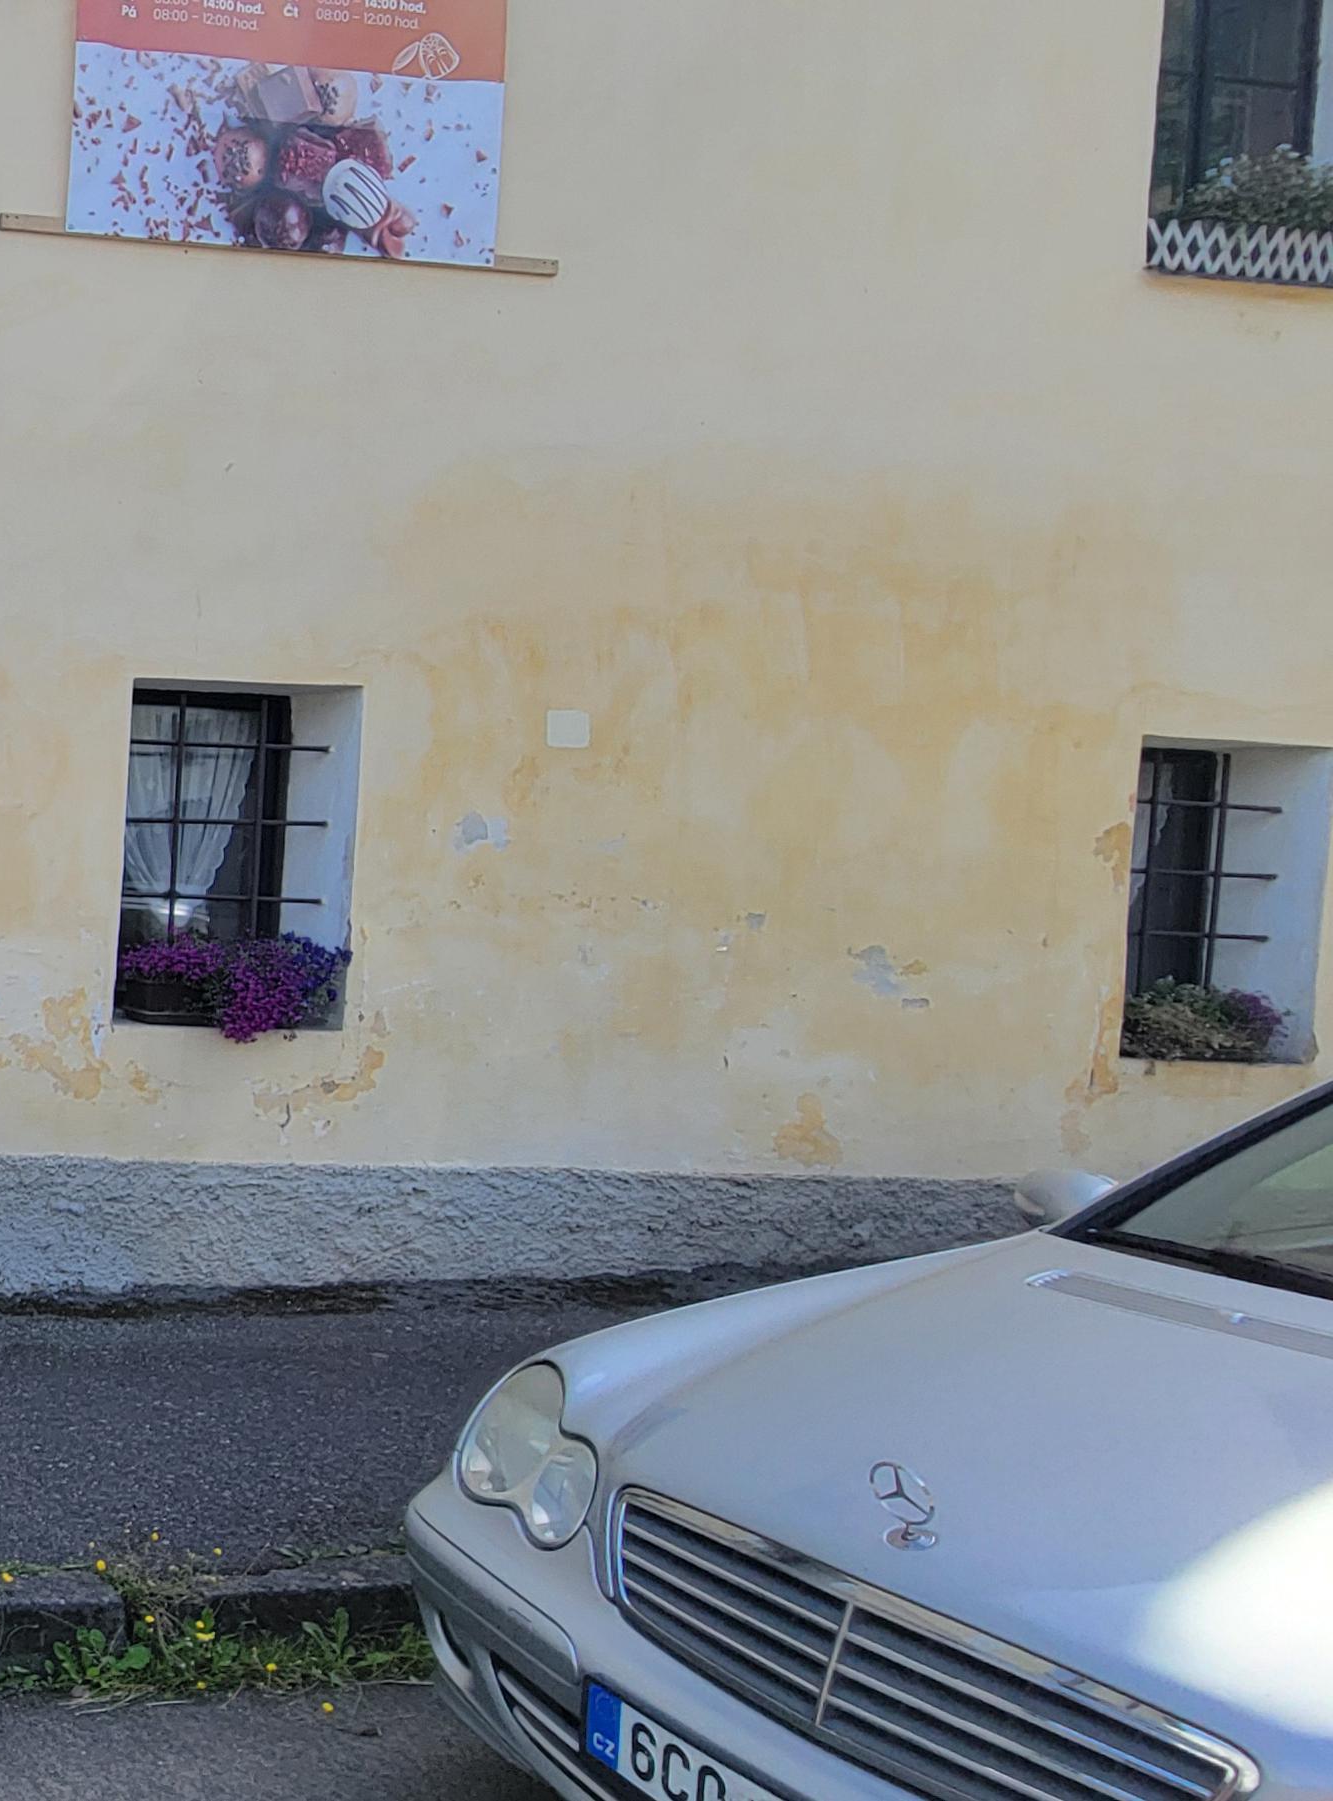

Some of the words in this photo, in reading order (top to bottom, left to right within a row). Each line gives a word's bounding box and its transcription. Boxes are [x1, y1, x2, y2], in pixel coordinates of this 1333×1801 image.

[121, 4, 137, 18] Pá
[153, 8, 188, 22] 08:00
[203, 12, 231, 26] 12:00
[316, 8, 349, 22] 08:00
[364, 12, 392, 26] 12:00
[591, 1730, 617, 1760] CZ
